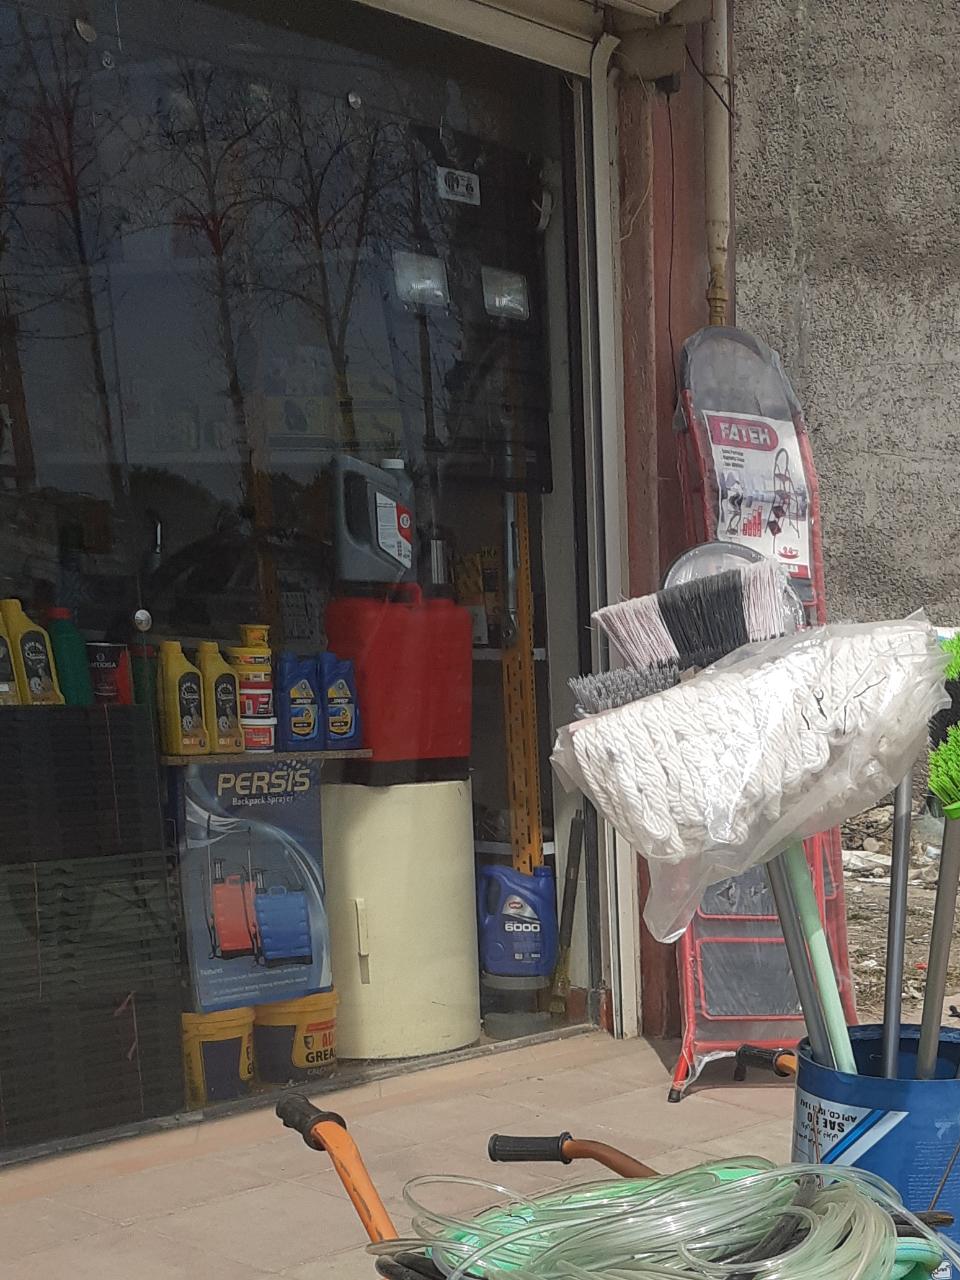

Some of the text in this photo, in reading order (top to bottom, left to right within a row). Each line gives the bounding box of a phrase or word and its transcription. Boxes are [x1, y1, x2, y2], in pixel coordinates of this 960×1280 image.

[719, 422, 770, 446] FATEH
[217, 769, 310, 796] PERSIS
[232, 795, 294, 806] Backpack Sprayer
[504, 923, 540, 932] 6000
[305, 1048, 336, 1063] GREA
[823, 1117, 845, 1133] SAE
[842, 1113, 857, 1122] API
